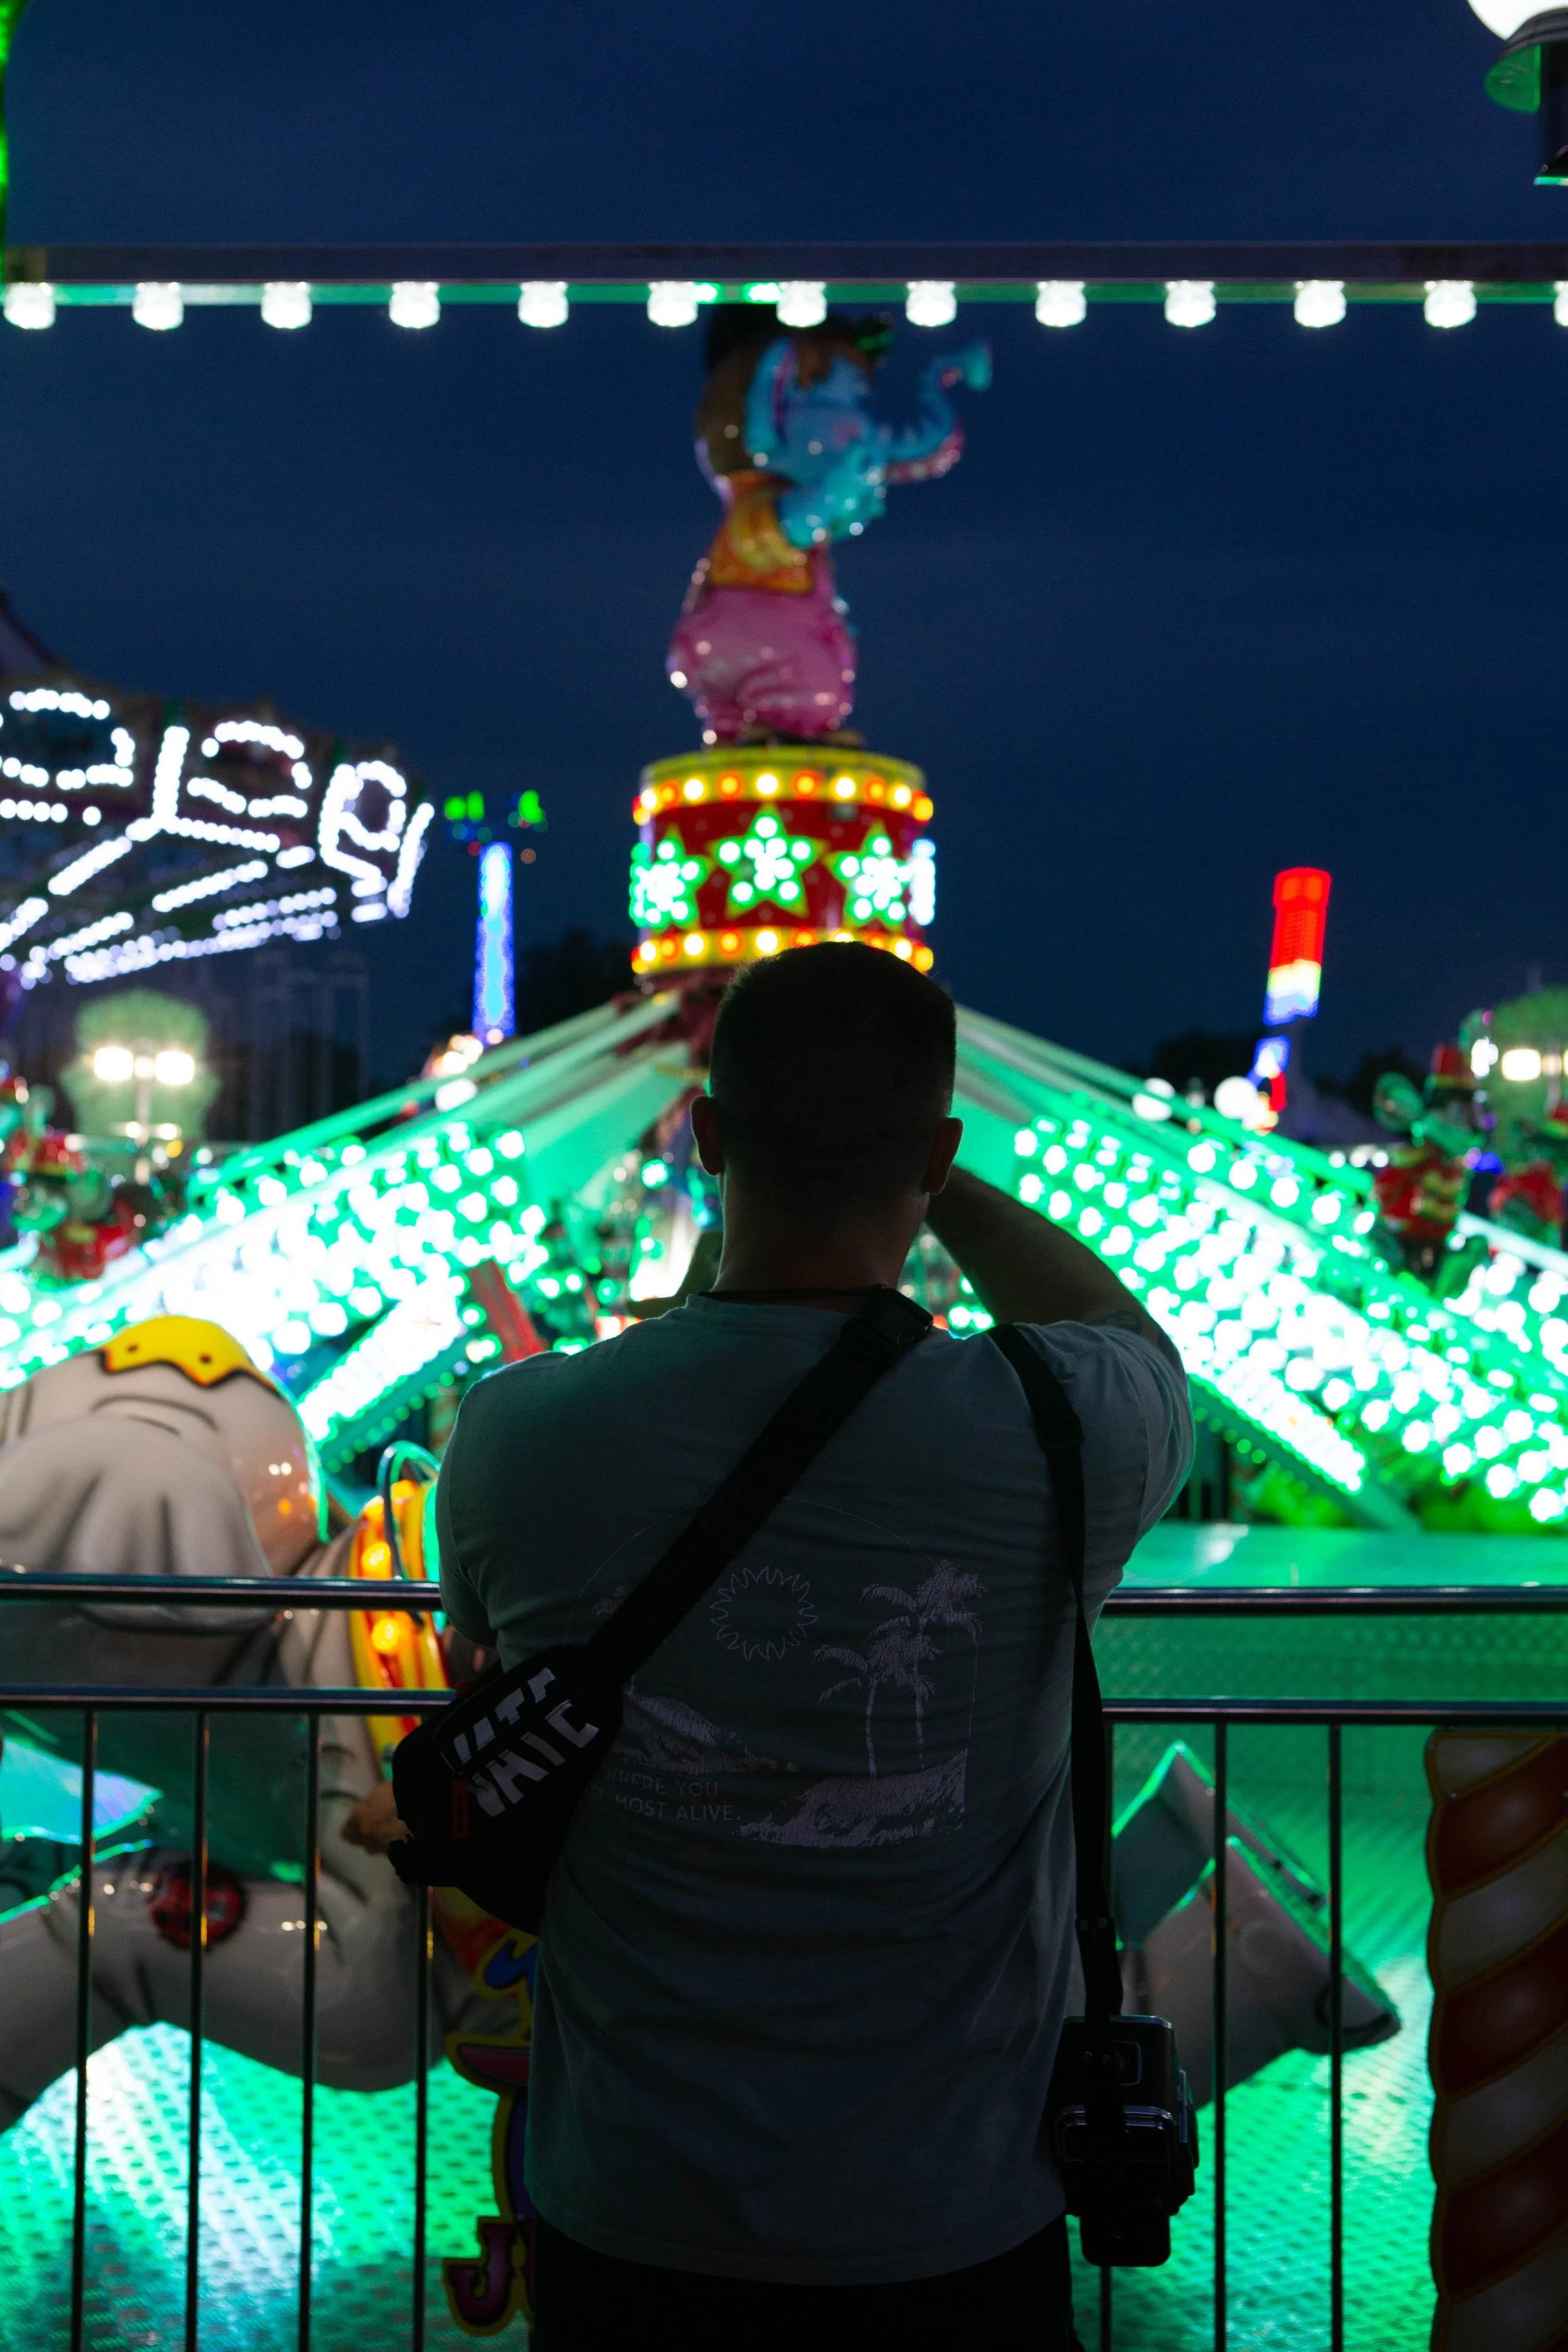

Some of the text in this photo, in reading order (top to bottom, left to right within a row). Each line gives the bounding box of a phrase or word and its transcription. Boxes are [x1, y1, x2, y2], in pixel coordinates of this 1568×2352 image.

[603, 1768, 667, 1795] WHERE
[675, 1780, 719, 1796] YOU
[615, 1793, 741, 1821] MOST ALIVE.
